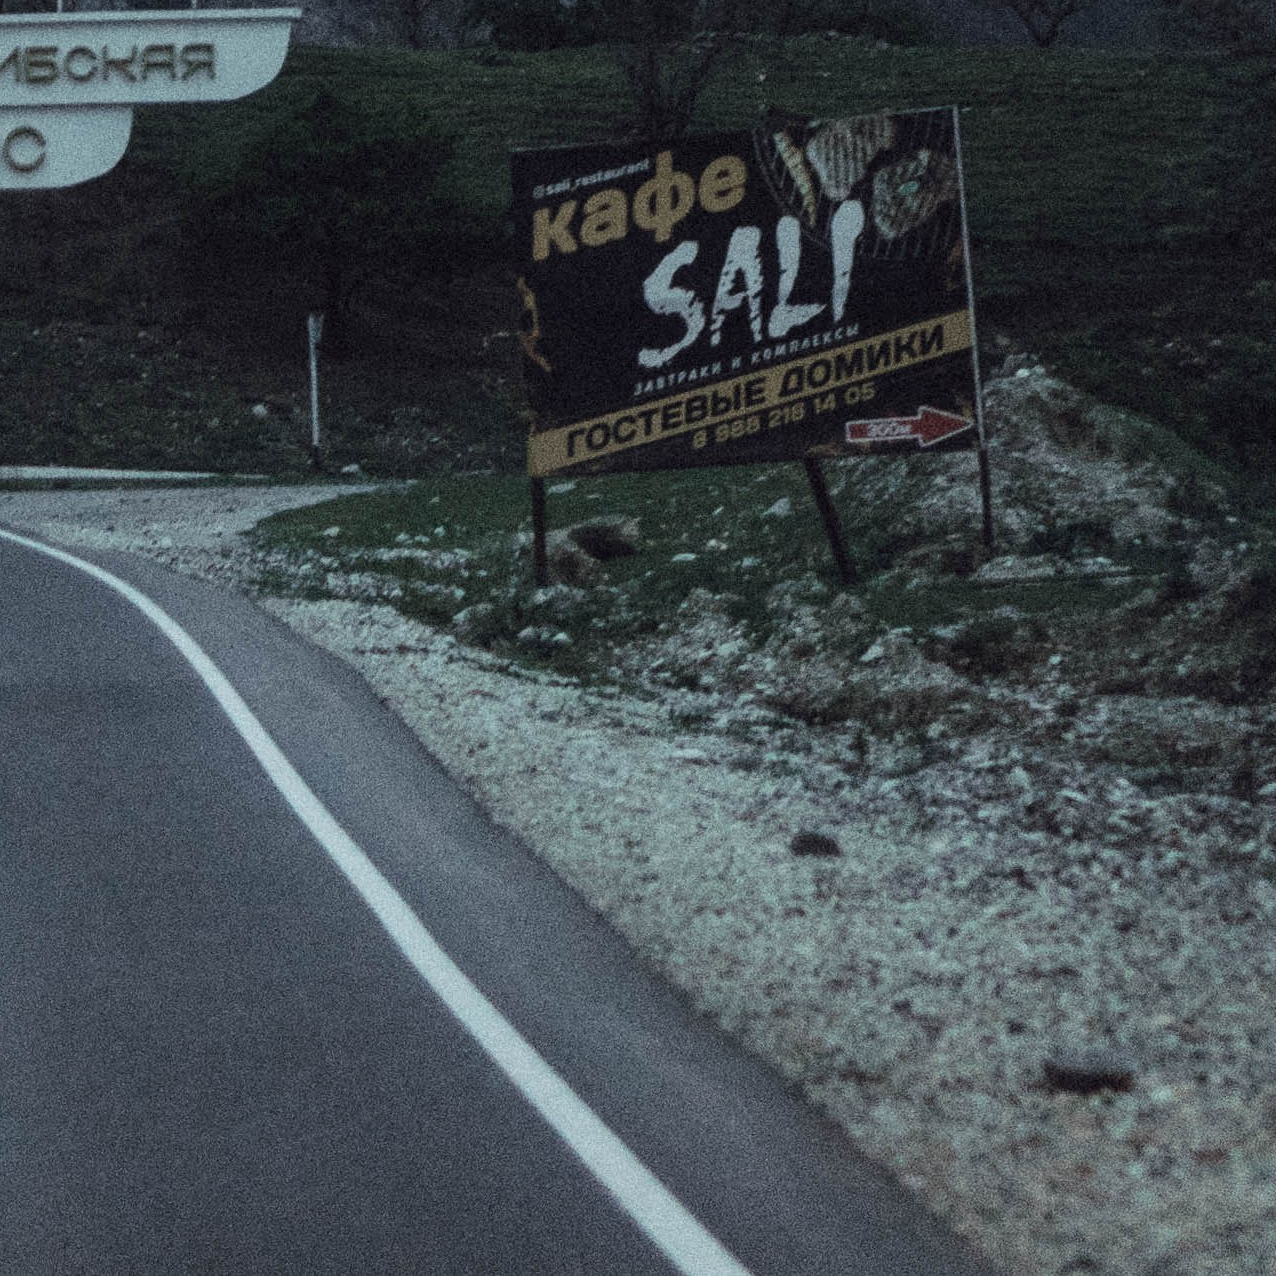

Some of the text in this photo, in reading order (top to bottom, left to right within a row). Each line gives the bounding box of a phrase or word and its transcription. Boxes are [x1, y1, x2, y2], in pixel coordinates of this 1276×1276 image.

[532, 151, 748, 262] кафе
[638, 199, 865, 367] SALI
[566, 322, 946, 458] ГОСТЕВЫЕ ДОМИКИ
[633, 322, 861, 397] ЗАВТРАКИ И КОМПЛЕКСЫ
[693, 430, 708, 450] 8
[813, 392, 837, 416] 14
[845, 381, 877, 406] 05
